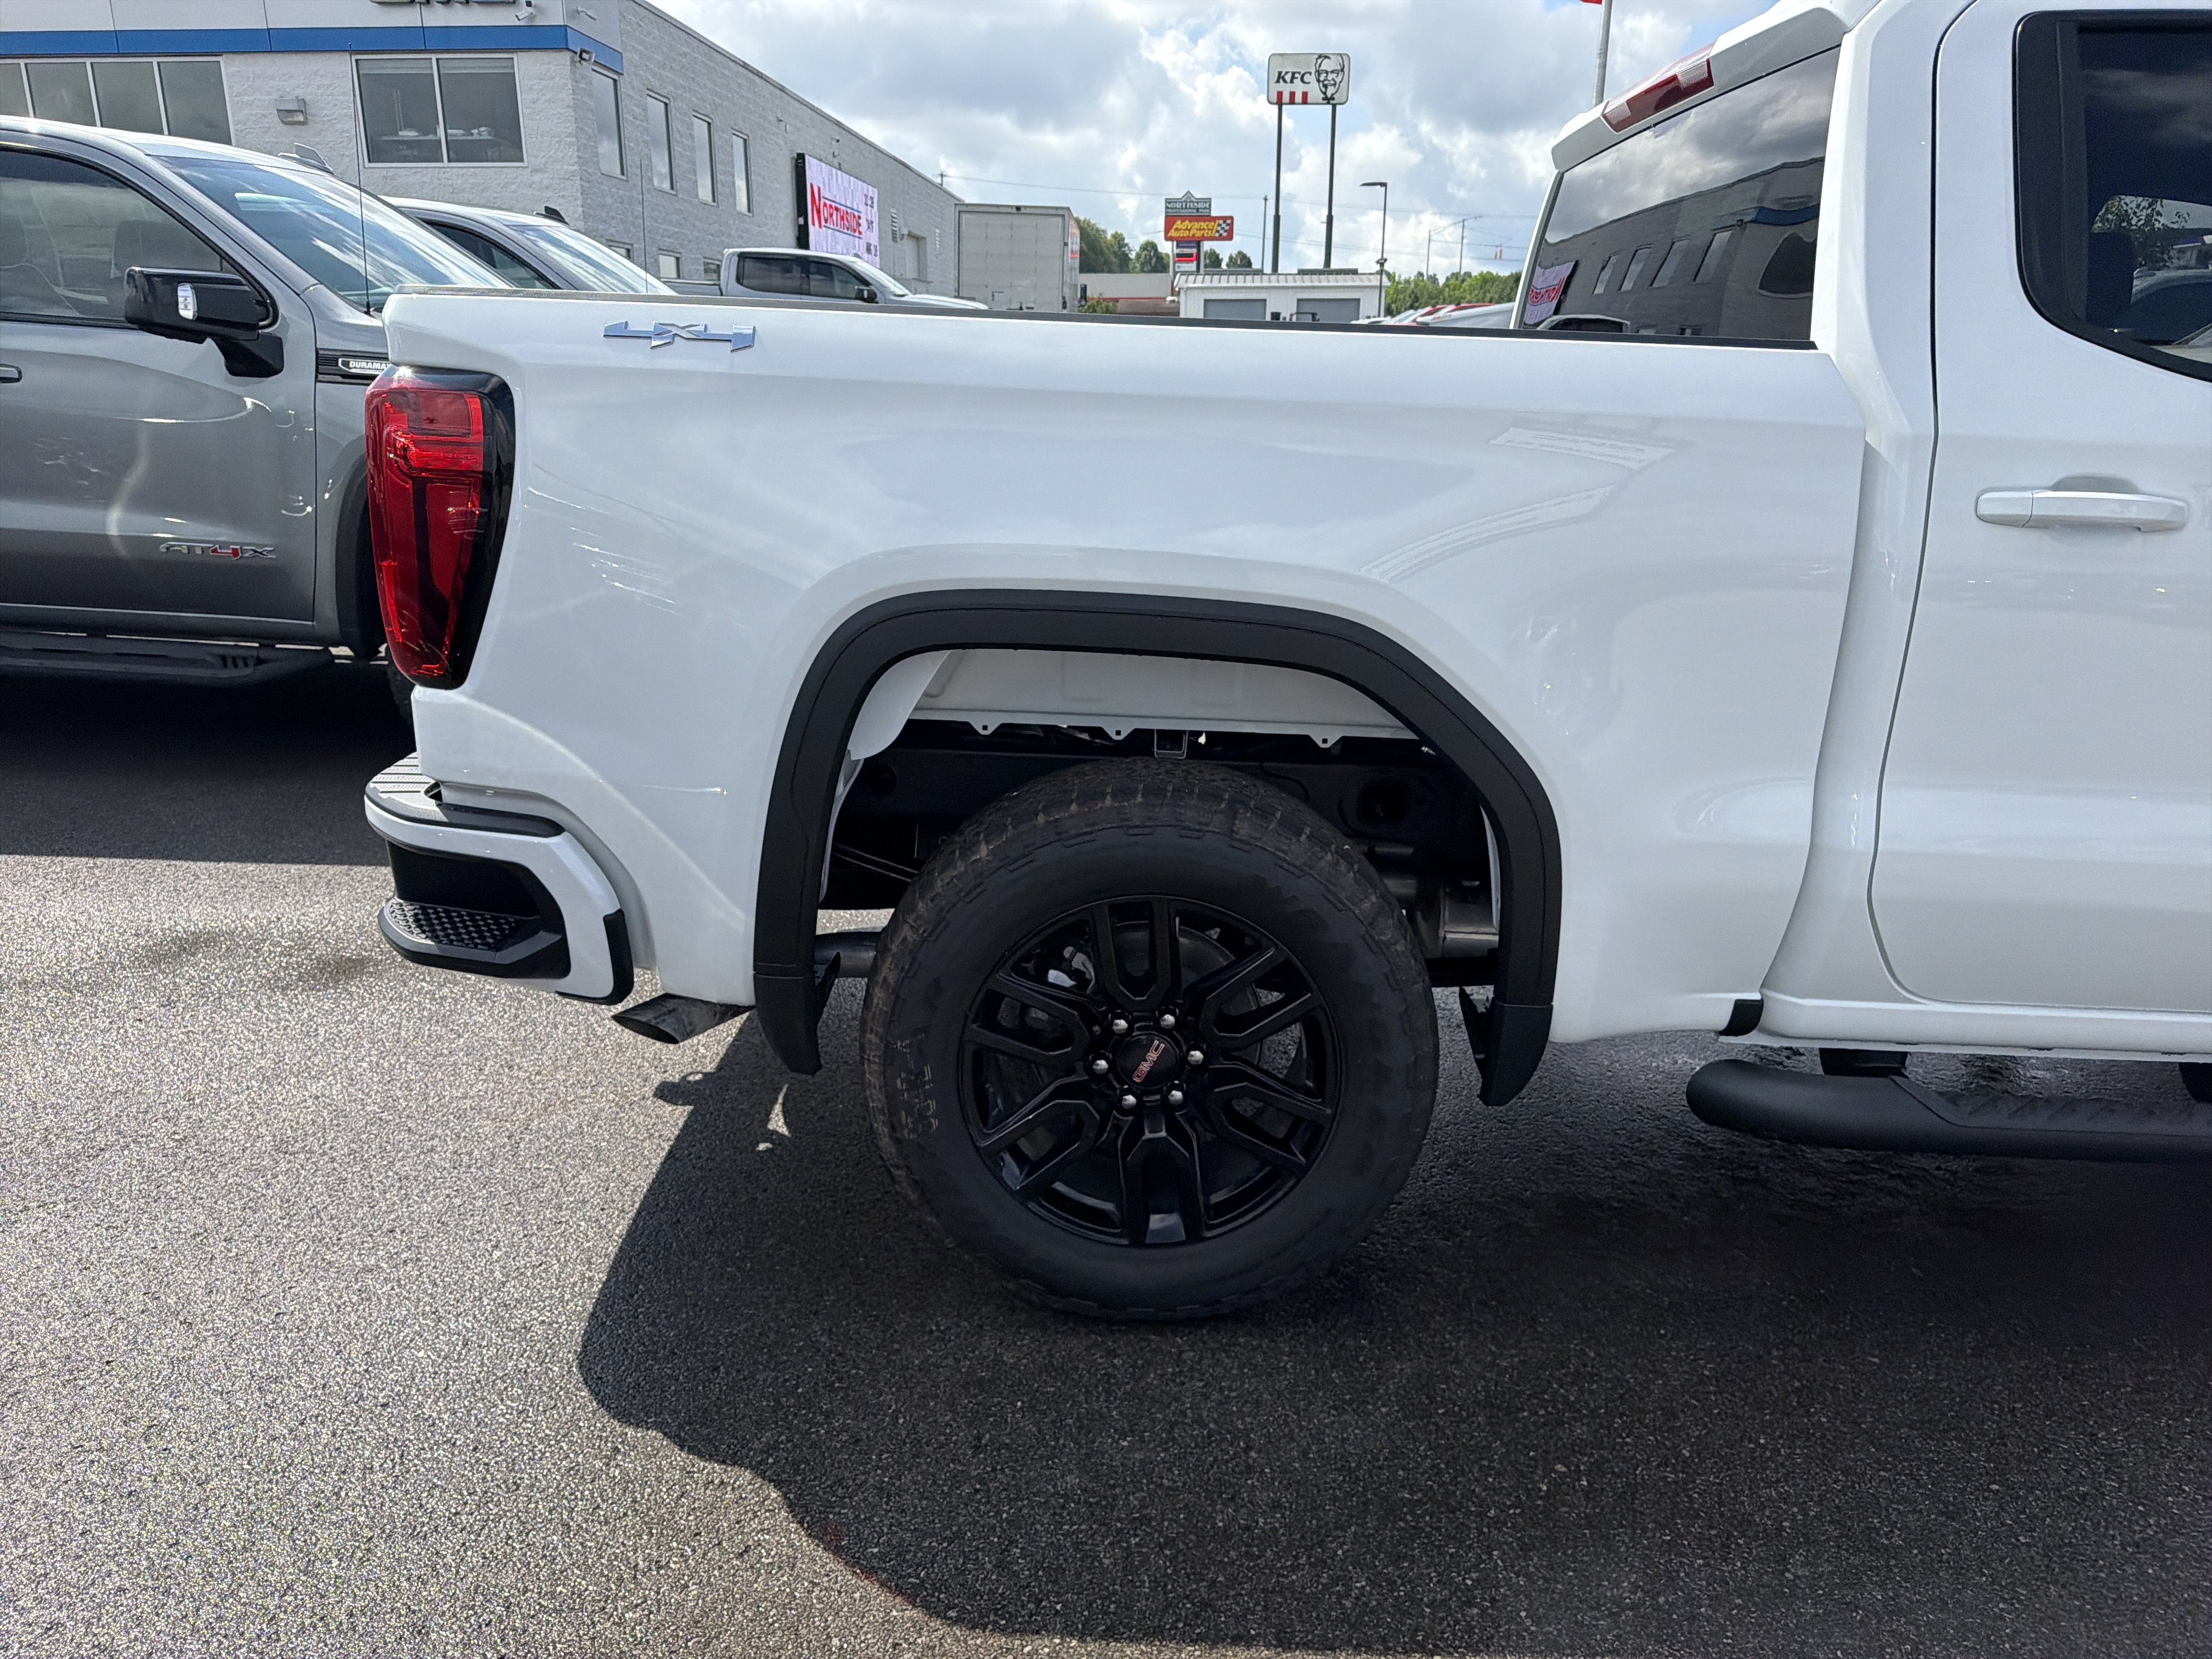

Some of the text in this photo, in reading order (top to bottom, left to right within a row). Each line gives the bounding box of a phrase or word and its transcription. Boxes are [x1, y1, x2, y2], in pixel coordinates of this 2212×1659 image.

[1274, 71, 1312, 84] KFC
[1173, 220, 1215, 229] Advance
[1167, 228, 1213, 237] Auto Parts
[1132, 1040, 1165, 1083] GMC
